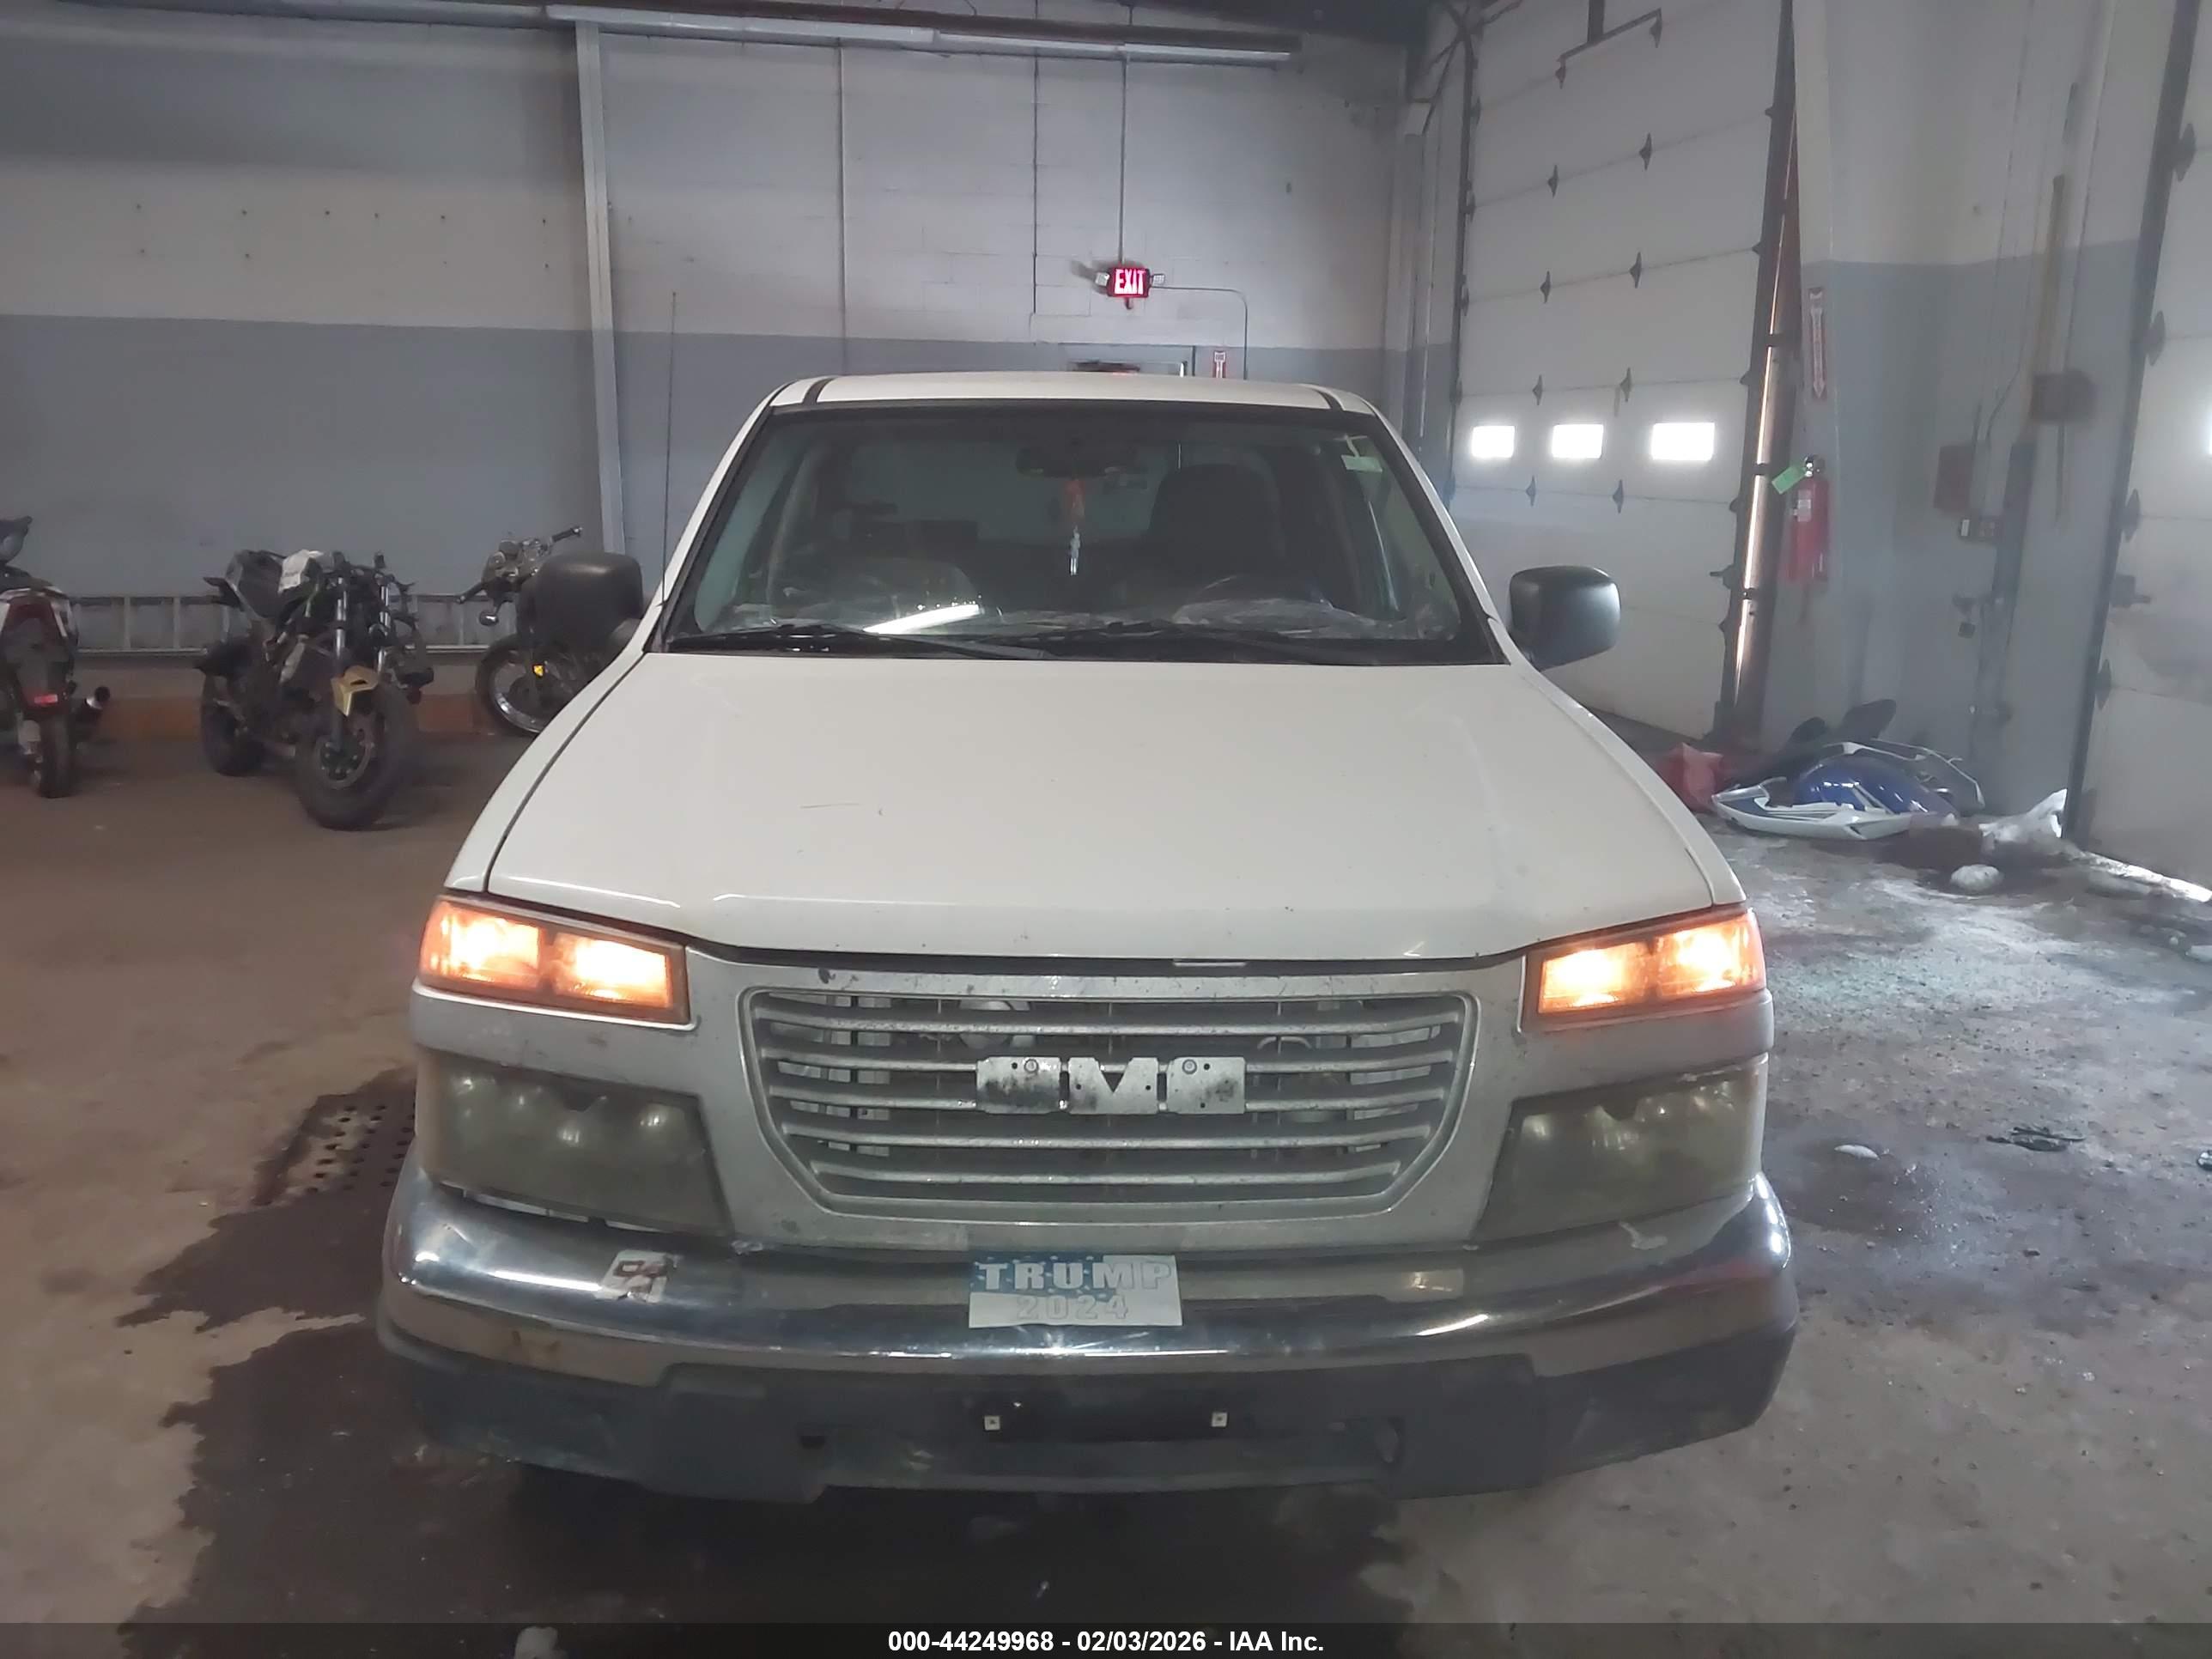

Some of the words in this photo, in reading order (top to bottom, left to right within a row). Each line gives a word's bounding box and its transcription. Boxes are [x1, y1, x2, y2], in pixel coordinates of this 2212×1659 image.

[1114, 269, 1146, 295] EXIT
[977, 1261, 1172, 1291] TRUMP
[1016, 1293, 1129, 1320] 2024
